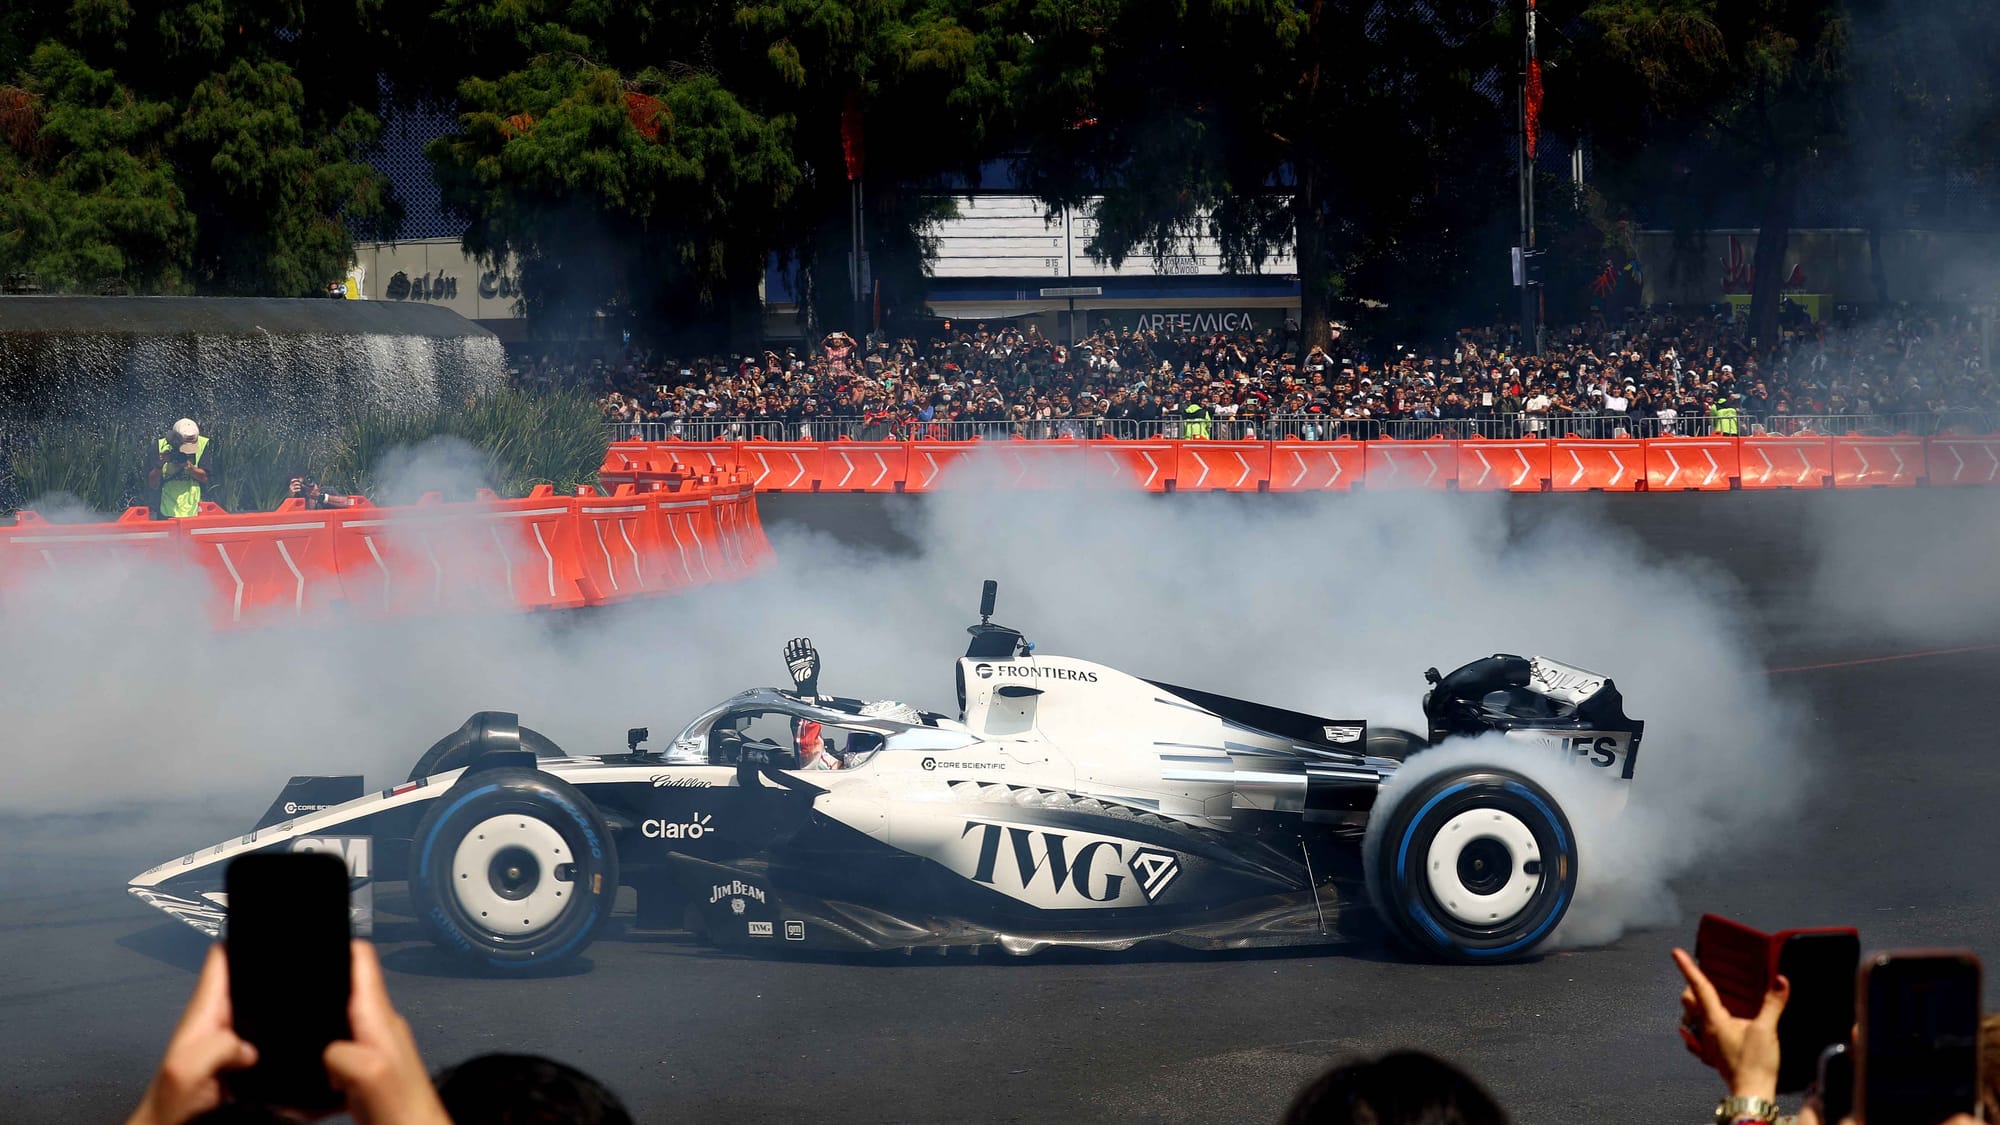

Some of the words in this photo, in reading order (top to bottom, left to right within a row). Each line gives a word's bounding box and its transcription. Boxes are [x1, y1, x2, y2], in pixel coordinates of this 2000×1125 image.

[385, 268, 457, 300] Salón
[998, 665, 1098, 683] FRONTIERAS
[938, 761, 960, 769] CORE
[962, 762, 1006, 770] SCIENTIFIC
[650, 774, 712, 789] Cadillac
[641, 819, 704, 839] Claro
[961, 820, 1126, 902] TWG
[709, 884, 732, 904] JIM
[732, 880, 766, 905] BEAM
[751, 924, 771, 932] TWG
